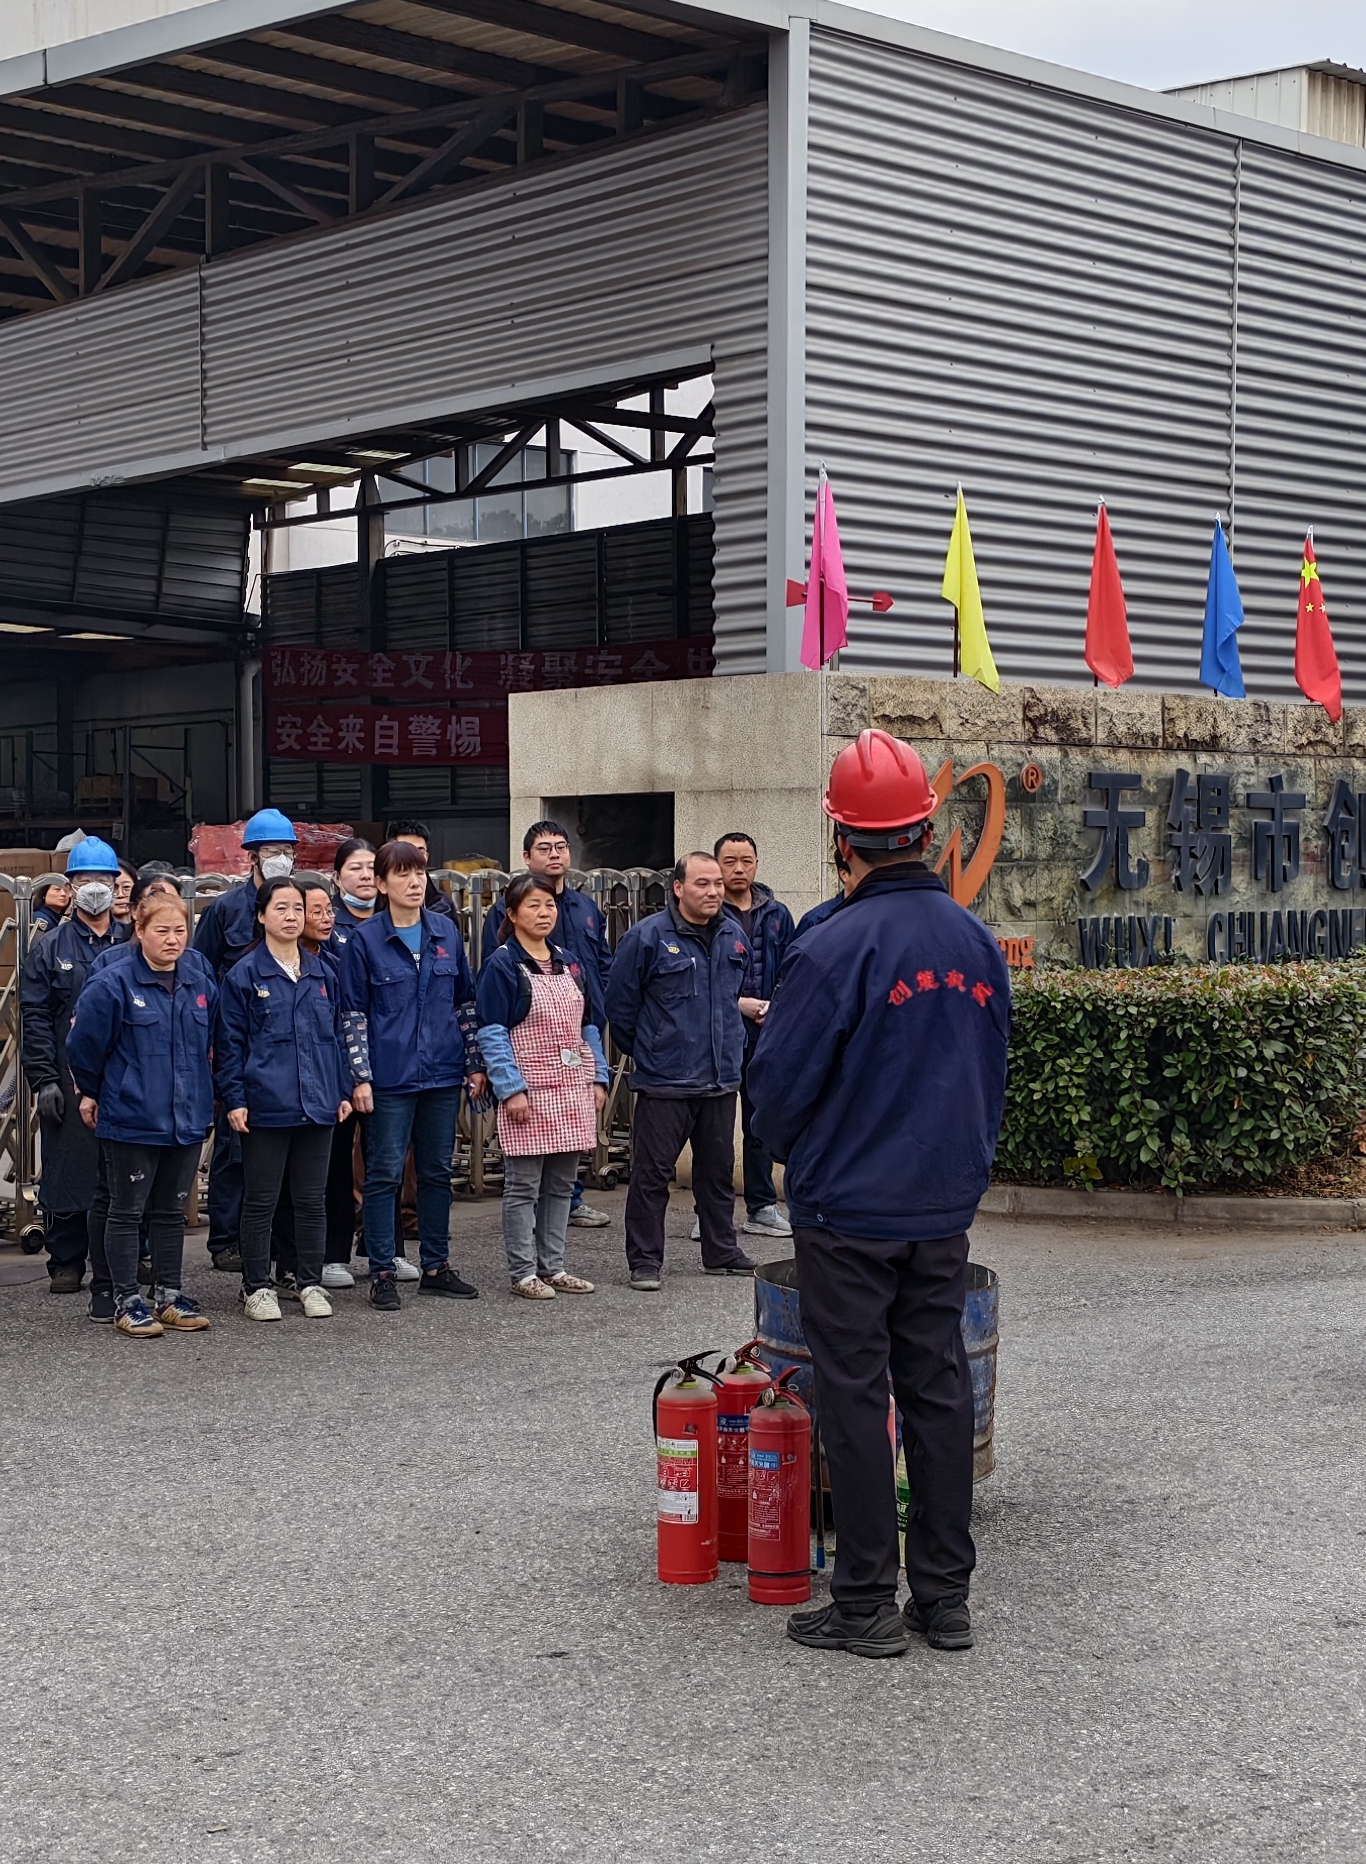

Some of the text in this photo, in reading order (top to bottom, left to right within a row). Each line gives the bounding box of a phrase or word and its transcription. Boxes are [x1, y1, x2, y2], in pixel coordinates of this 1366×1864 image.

[276, 713, 483, 757] 安全来自警惕
